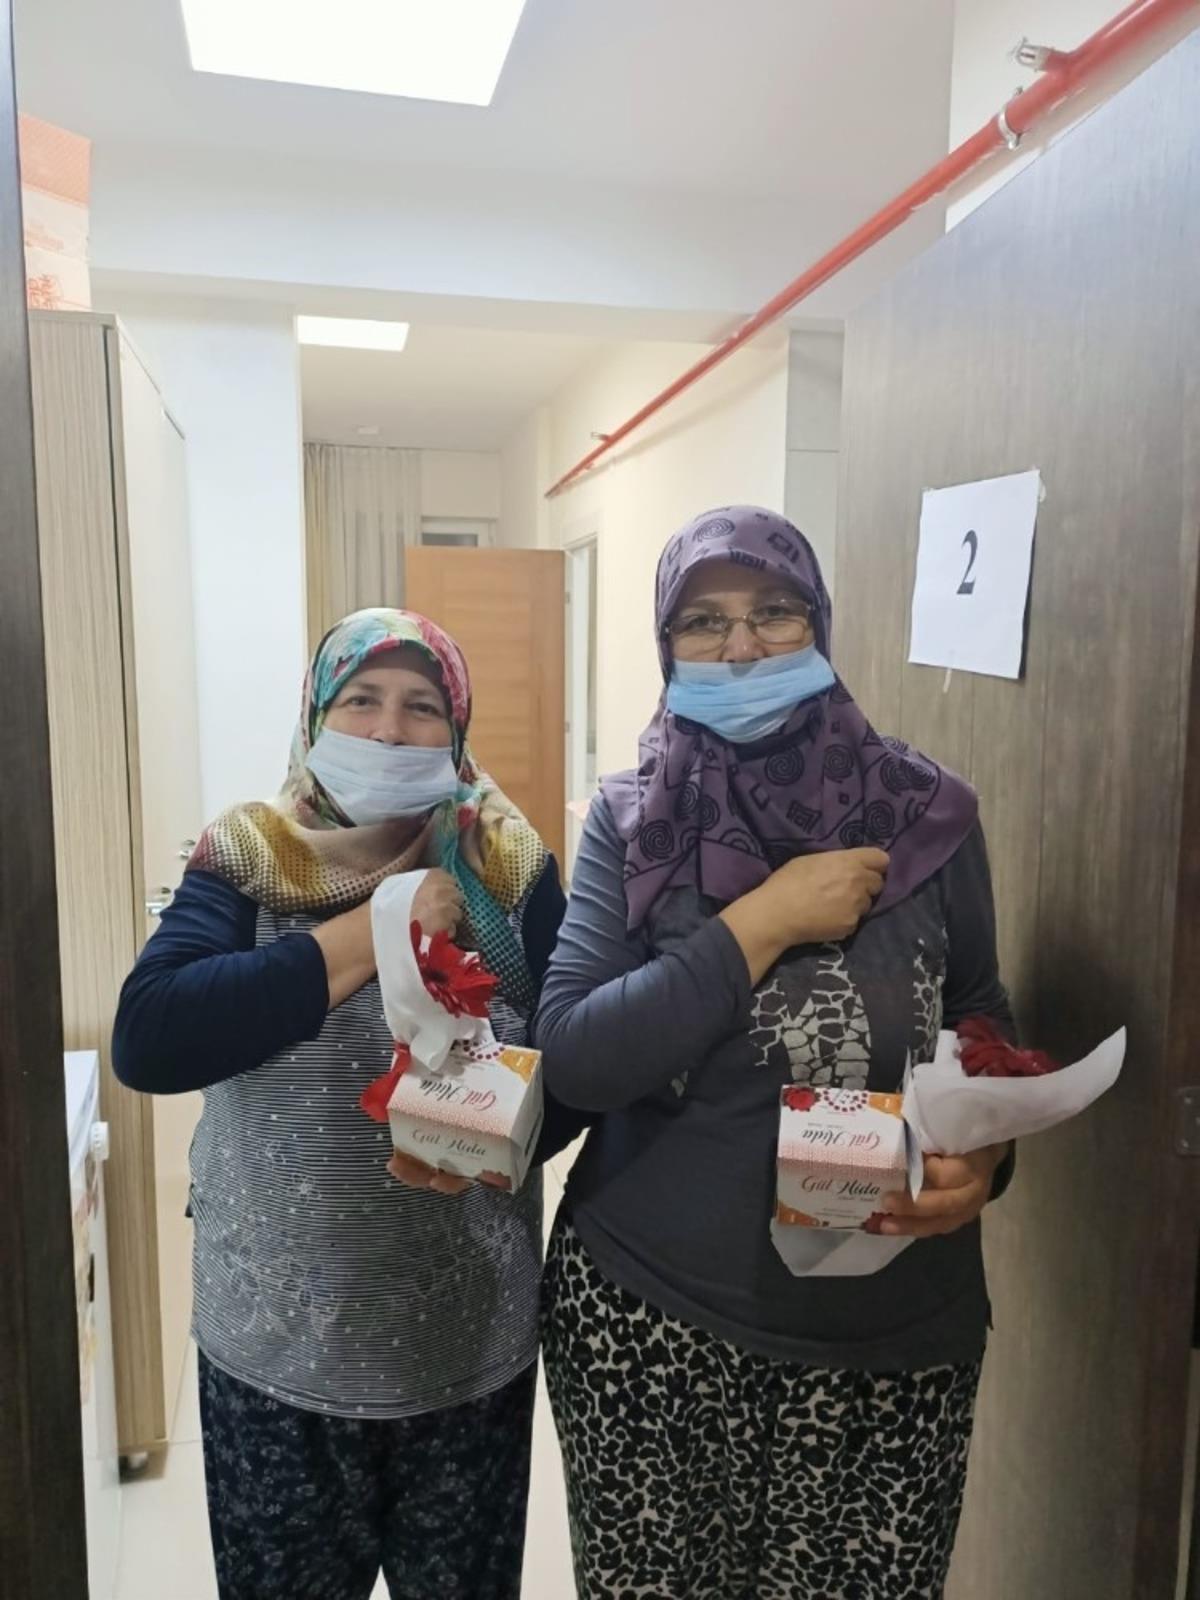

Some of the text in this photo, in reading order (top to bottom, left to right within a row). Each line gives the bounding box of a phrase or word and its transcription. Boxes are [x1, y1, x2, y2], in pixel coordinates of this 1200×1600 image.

[956, 529, 978, 595] 2
[848, 1131, 881, 1151] Gül
[801, 1175, 833, 1193] Gül
